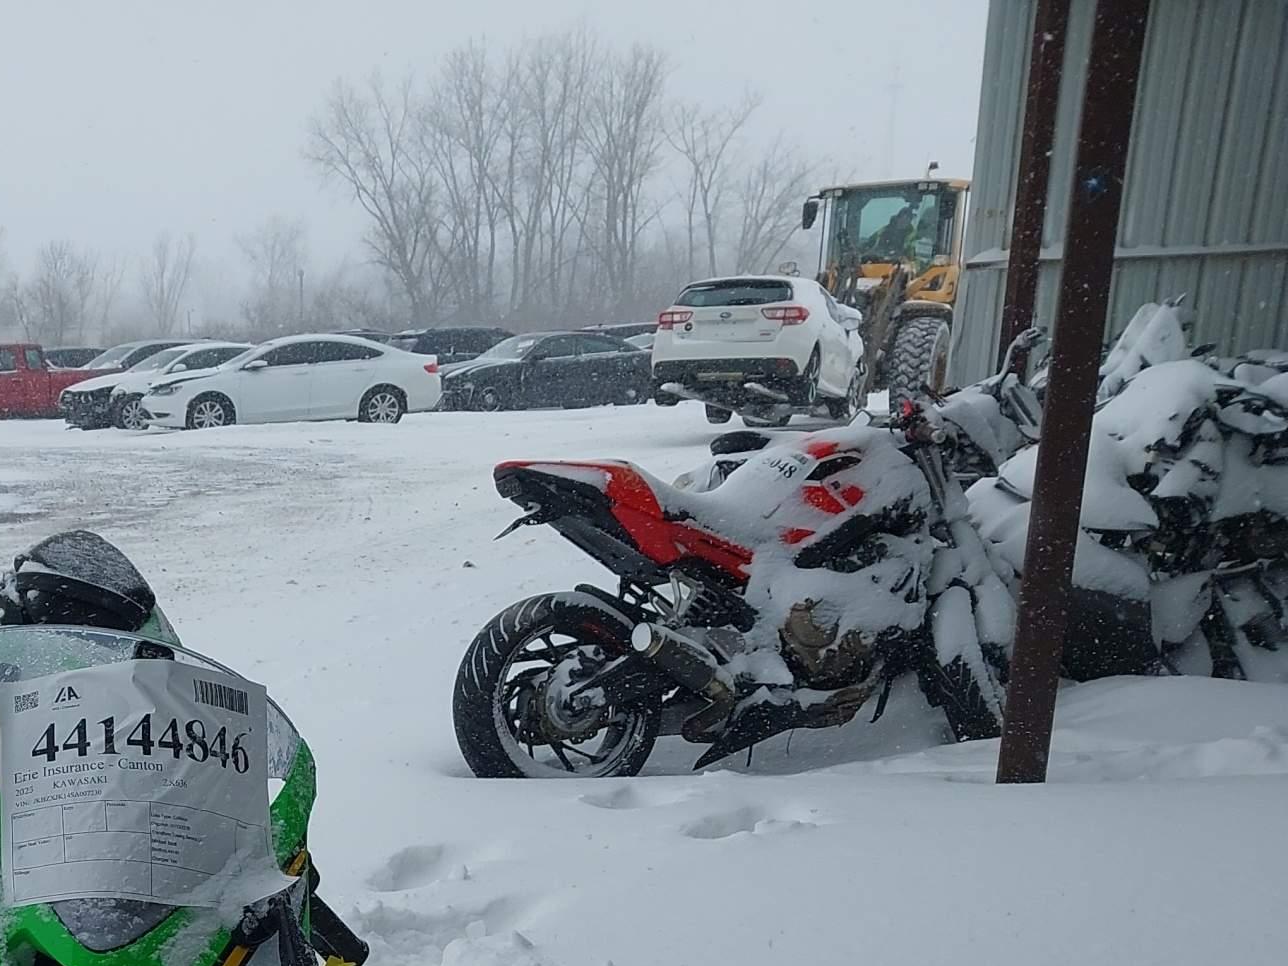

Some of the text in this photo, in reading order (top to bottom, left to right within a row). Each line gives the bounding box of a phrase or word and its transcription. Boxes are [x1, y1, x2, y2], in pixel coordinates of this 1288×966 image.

[31, 714, 250, 774] 44144846
[14, 771, 39, 785] Erie
[42, 759, 105, 777] Insurance
[118, 759, 164, 772] Canton
[53, 776, 108, 789] KAWASAKI
